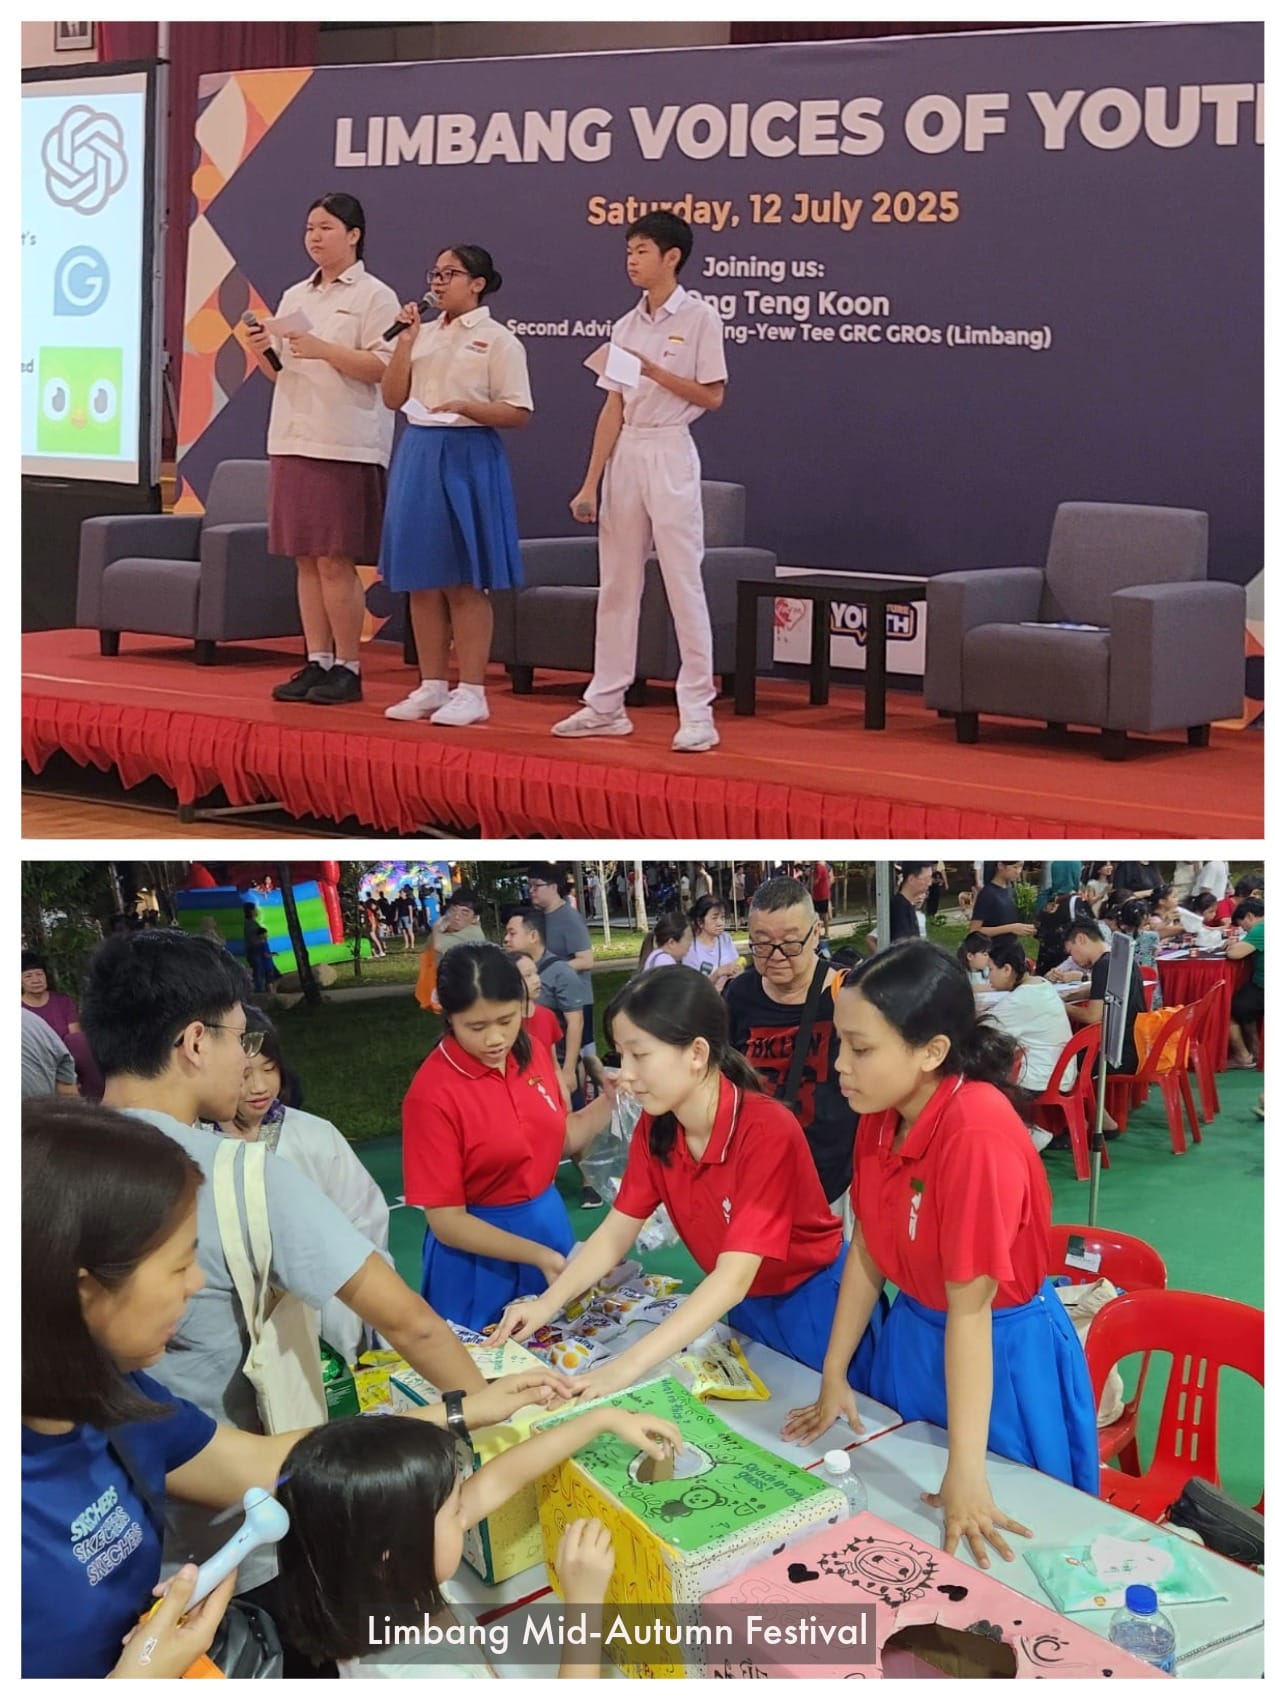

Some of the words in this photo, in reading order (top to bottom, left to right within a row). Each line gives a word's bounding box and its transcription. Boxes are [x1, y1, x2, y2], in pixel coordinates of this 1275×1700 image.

[334, 107, 613, 168] LIMBANG
[628, 97, 885, 160] VOICES
[905, 92, 1010, 154] OF
[1027, 82, 1264, 150] YOUT
[749, 194, 783, 224] 12
[790, 190, 863, 231] July
[870, 190, 961, 223] 2025
[702, 255, 786, 284] Joining
[791, 259, 826, 279] us:
[743, 290, 811, 322] Teng
[818, 290, 890, 317] Koon
[506, 318, 569, 337] Second
[572, 318, 613, 338] Advi
[723, 322, 797, 345] ng-Yew
[800, 323, 836, 343] Tee
[839, 325, 882, 344] GRC
[886, 325, 943, 345] GROs
[946, 325, 1053, 351] (Limbang)
